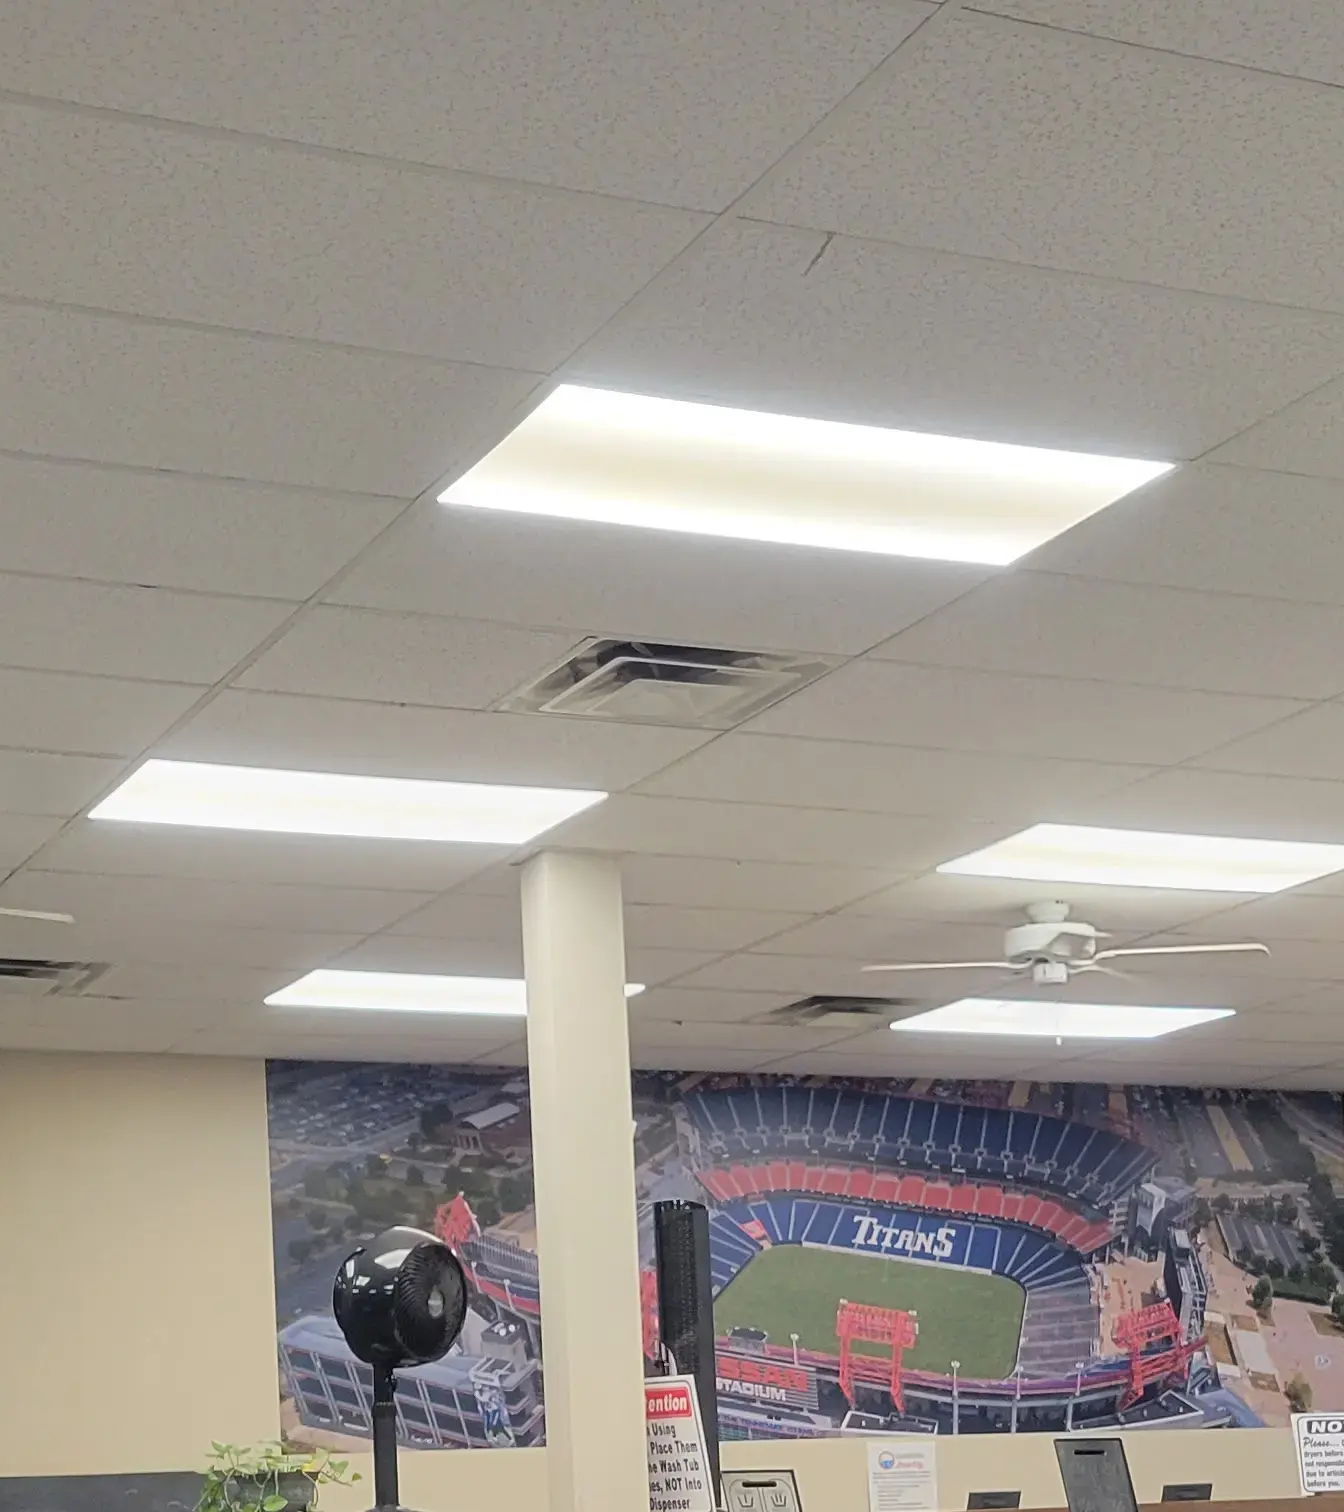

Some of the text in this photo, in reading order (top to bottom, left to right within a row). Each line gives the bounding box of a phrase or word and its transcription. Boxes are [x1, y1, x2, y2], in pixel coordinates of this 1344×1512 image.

[717, 1357, 808, 1392] SSAN
[648, 1393, 687, 1412] ention
[652, 1422, 676, 1438] Using
[650, 1440, 698, 1455] Place Them
[1304, 1451, 1323, 1459] dryers
[1325, 1450, 1344, 1458] before
[648, 1458, 699, 1473] he Wash Tub
[665, 1478, 682, 1492] NOT
[685, 1477, 702, 1490] Into
[1306, 1480, 1326, 1488] before
[649, 1497, 690, 1512] Dispenser
